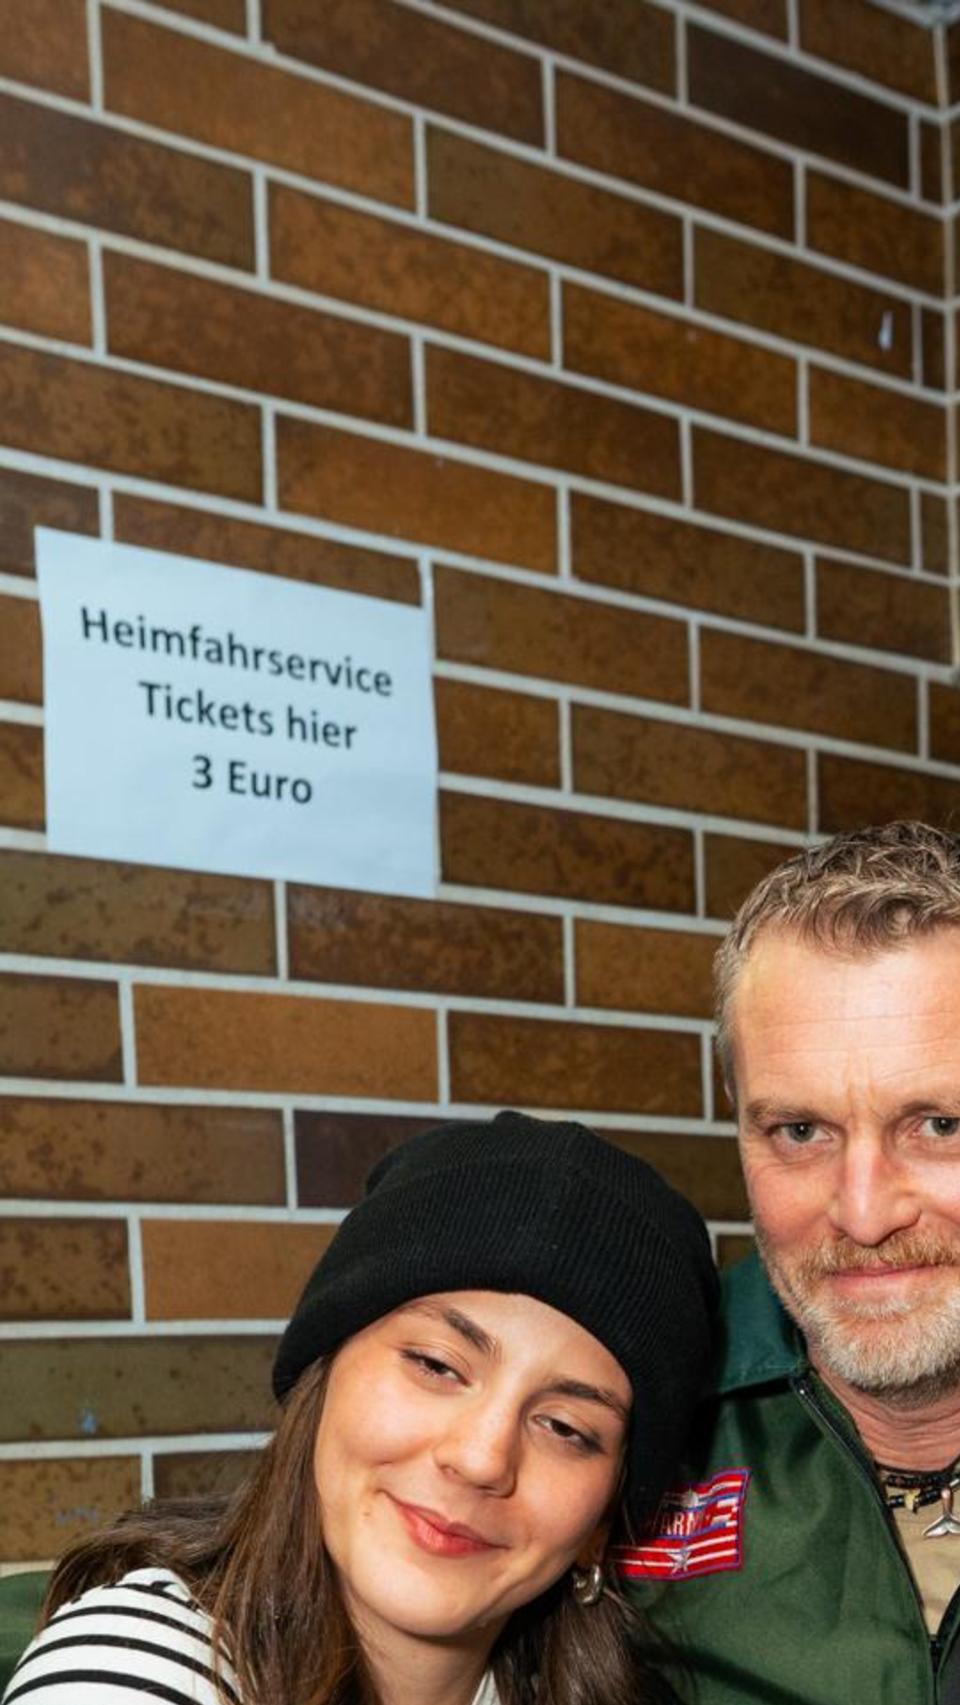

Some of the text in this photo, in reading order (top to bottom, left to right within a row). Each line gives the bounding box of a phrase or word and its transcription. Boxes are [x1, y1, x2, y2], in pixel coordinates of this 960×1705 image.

[81, 606, 393, 697] Heimfahrservice
[139, 681, 358, 750] Tickets hier
[191, 755, 313, 805] 3 Euro
